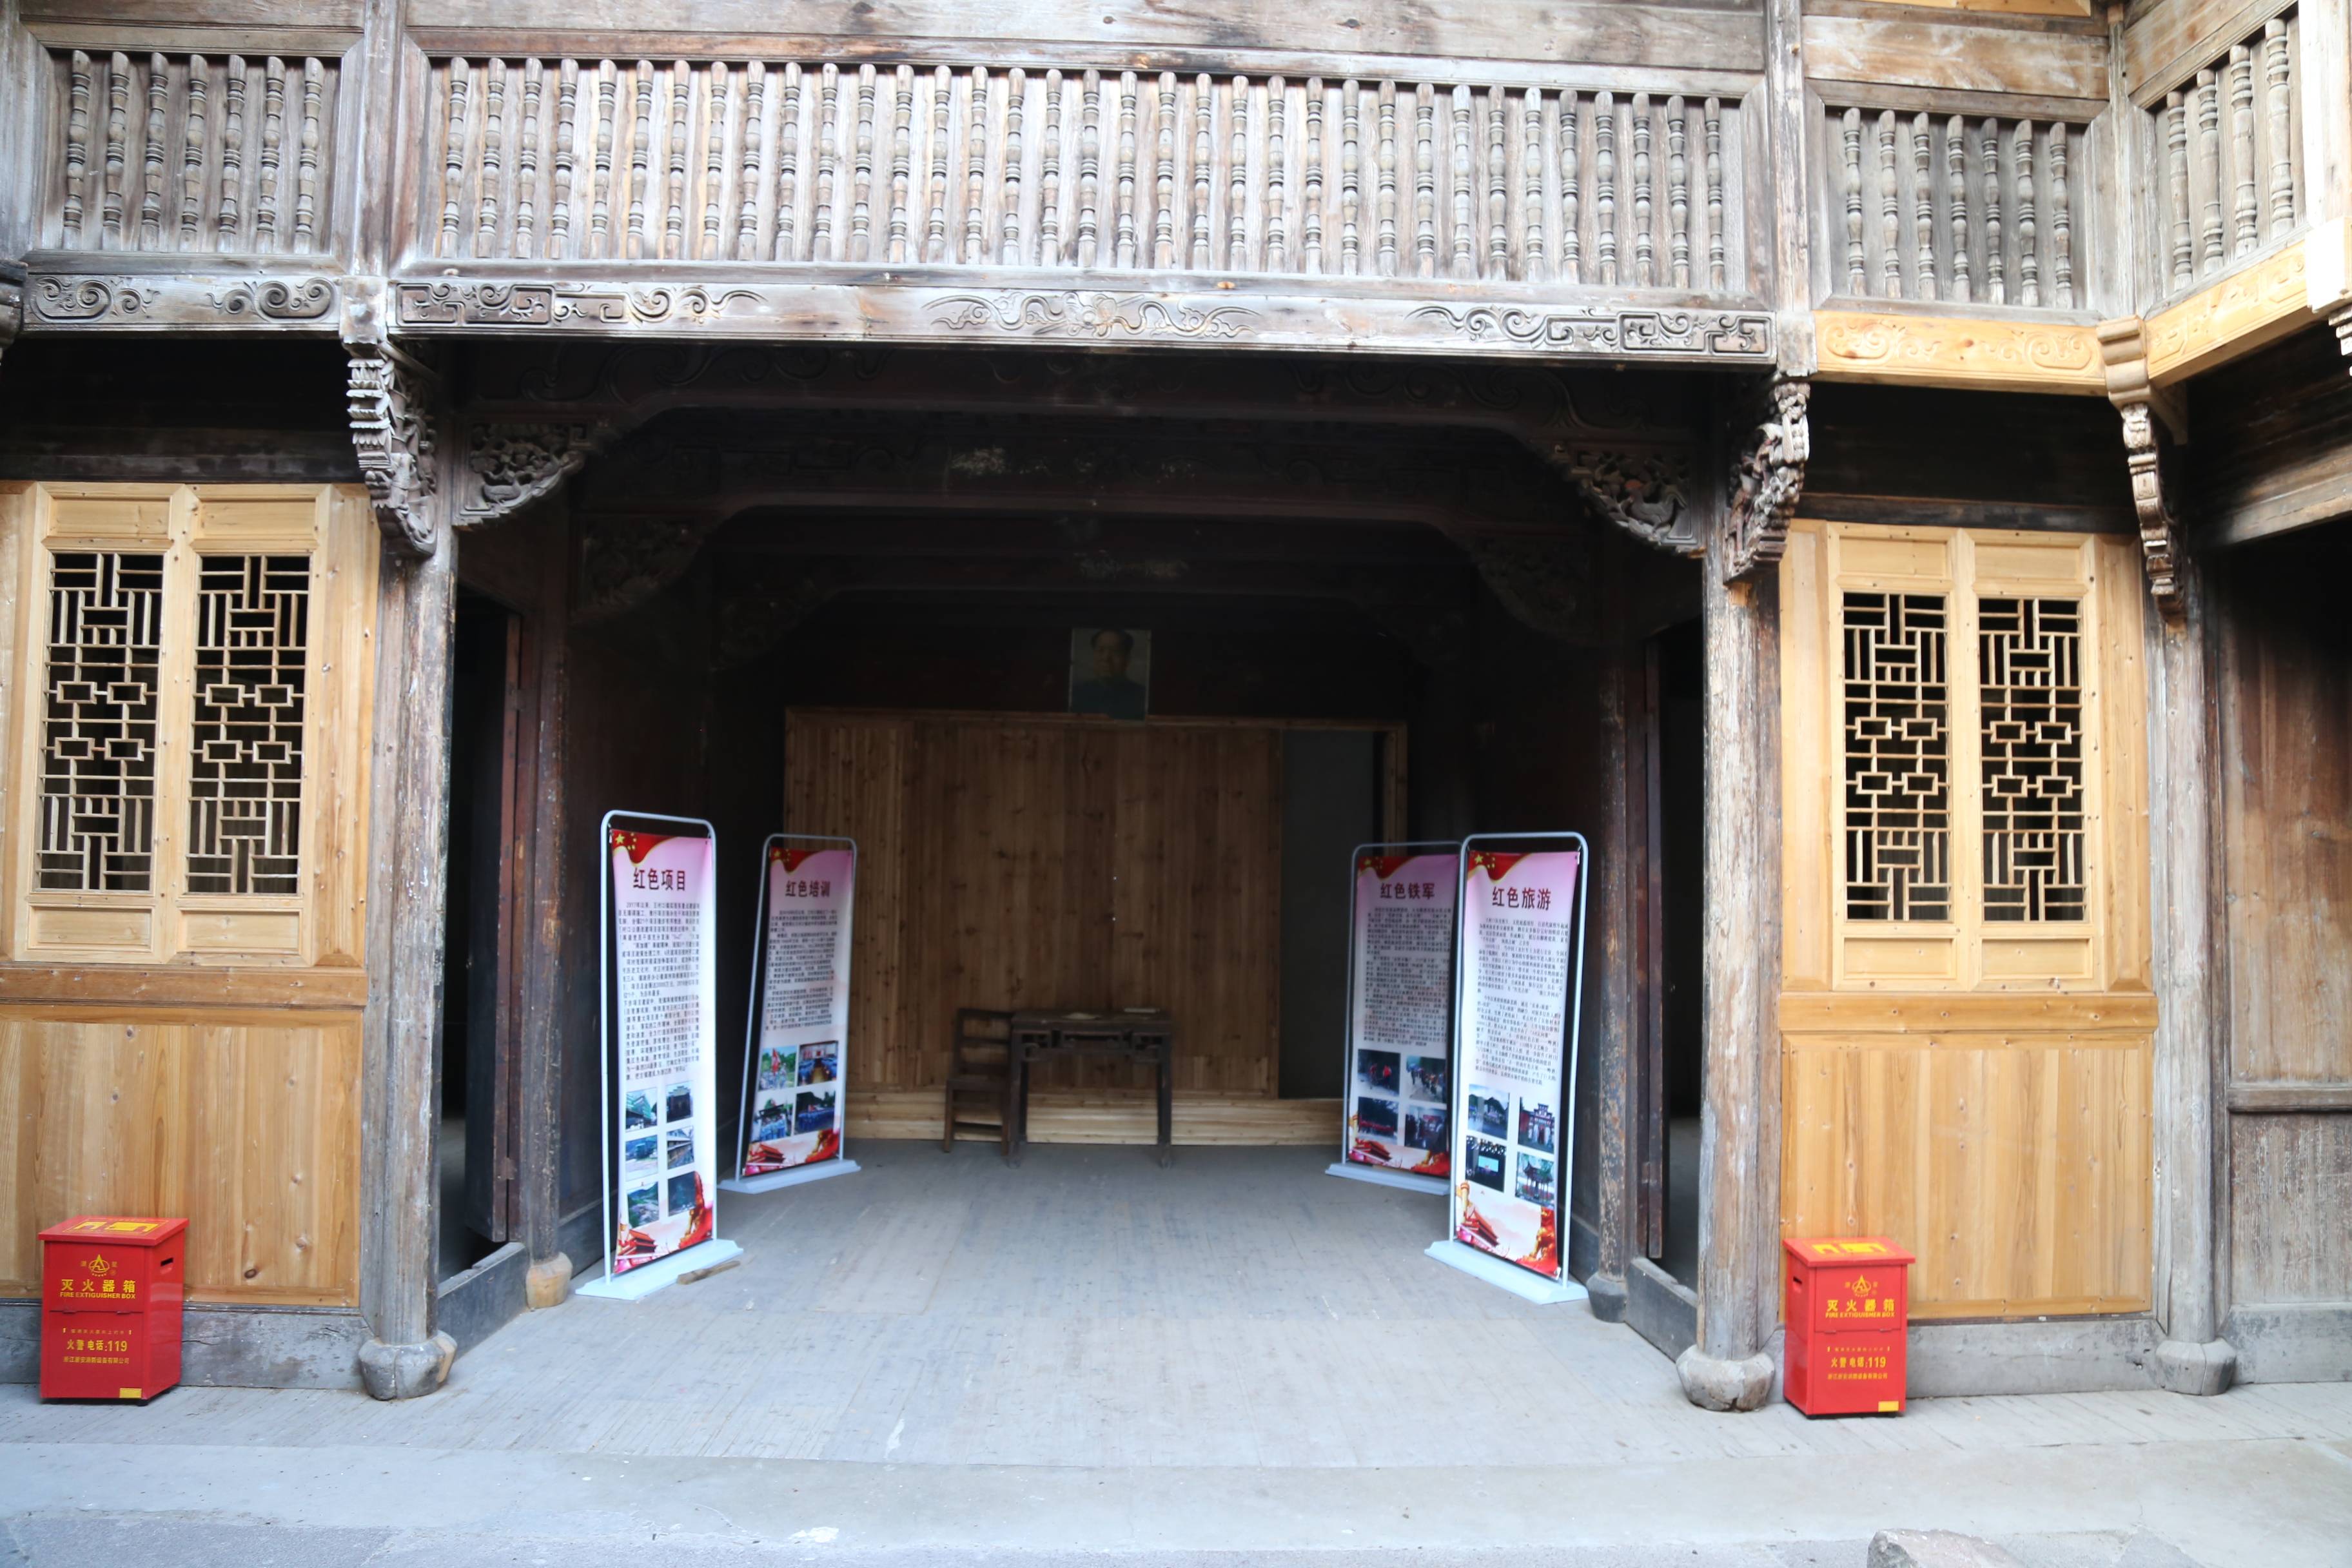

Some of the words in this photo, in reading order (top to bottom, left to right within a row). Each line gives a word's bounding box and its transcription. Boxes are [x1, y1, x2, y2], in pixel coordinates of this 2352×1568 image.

[632, 867, 685, 891] 红色项目
[785, 880, 831, 897] 红色培训
[1380, 882, 1435, 899] 红色铁军
[1492, 886, 1551, 911] 红色旅游
[61, 1279, 135, 1293] 灭火器箱
[1827, 1298, 1895, 1312] 灭火器箱
